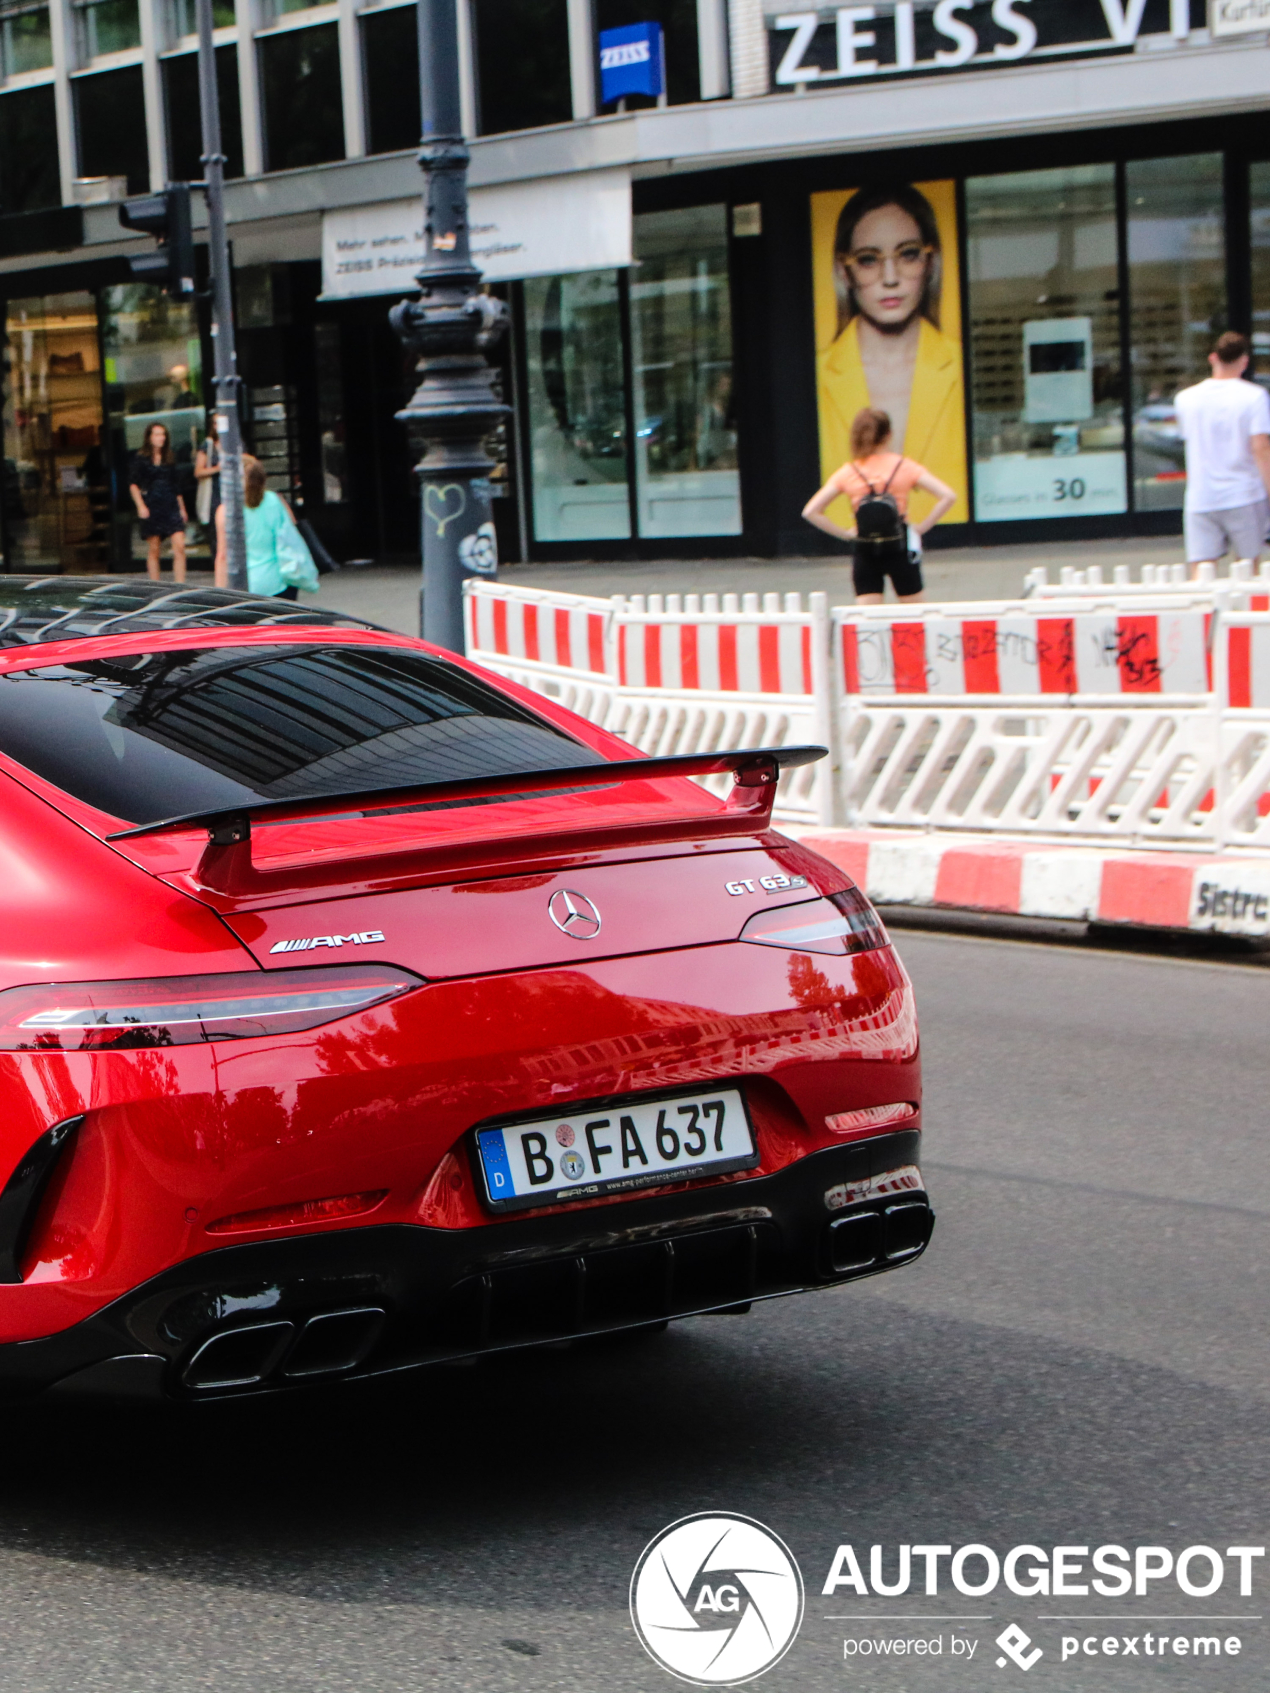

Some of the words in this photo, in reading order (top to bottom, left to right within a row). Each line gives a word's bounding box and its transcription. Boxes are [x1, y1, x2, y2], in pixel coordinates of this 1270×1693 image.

[775, 0, 1037, 84] ZEISS
[600, 40, 650, 69] ZEISS
[1052, 477, 1086, 501] 30
[724, 879, 755, 896] GT
[759, 874, 791, 890] 63
[308, 930, 386, 950] AMG
[521, 1132, 554, 1186] B
[585, 1115, 649, 1175] FA
[656, 1099, 727, 1161] 637
[494, 1172, 506, 1188] D
